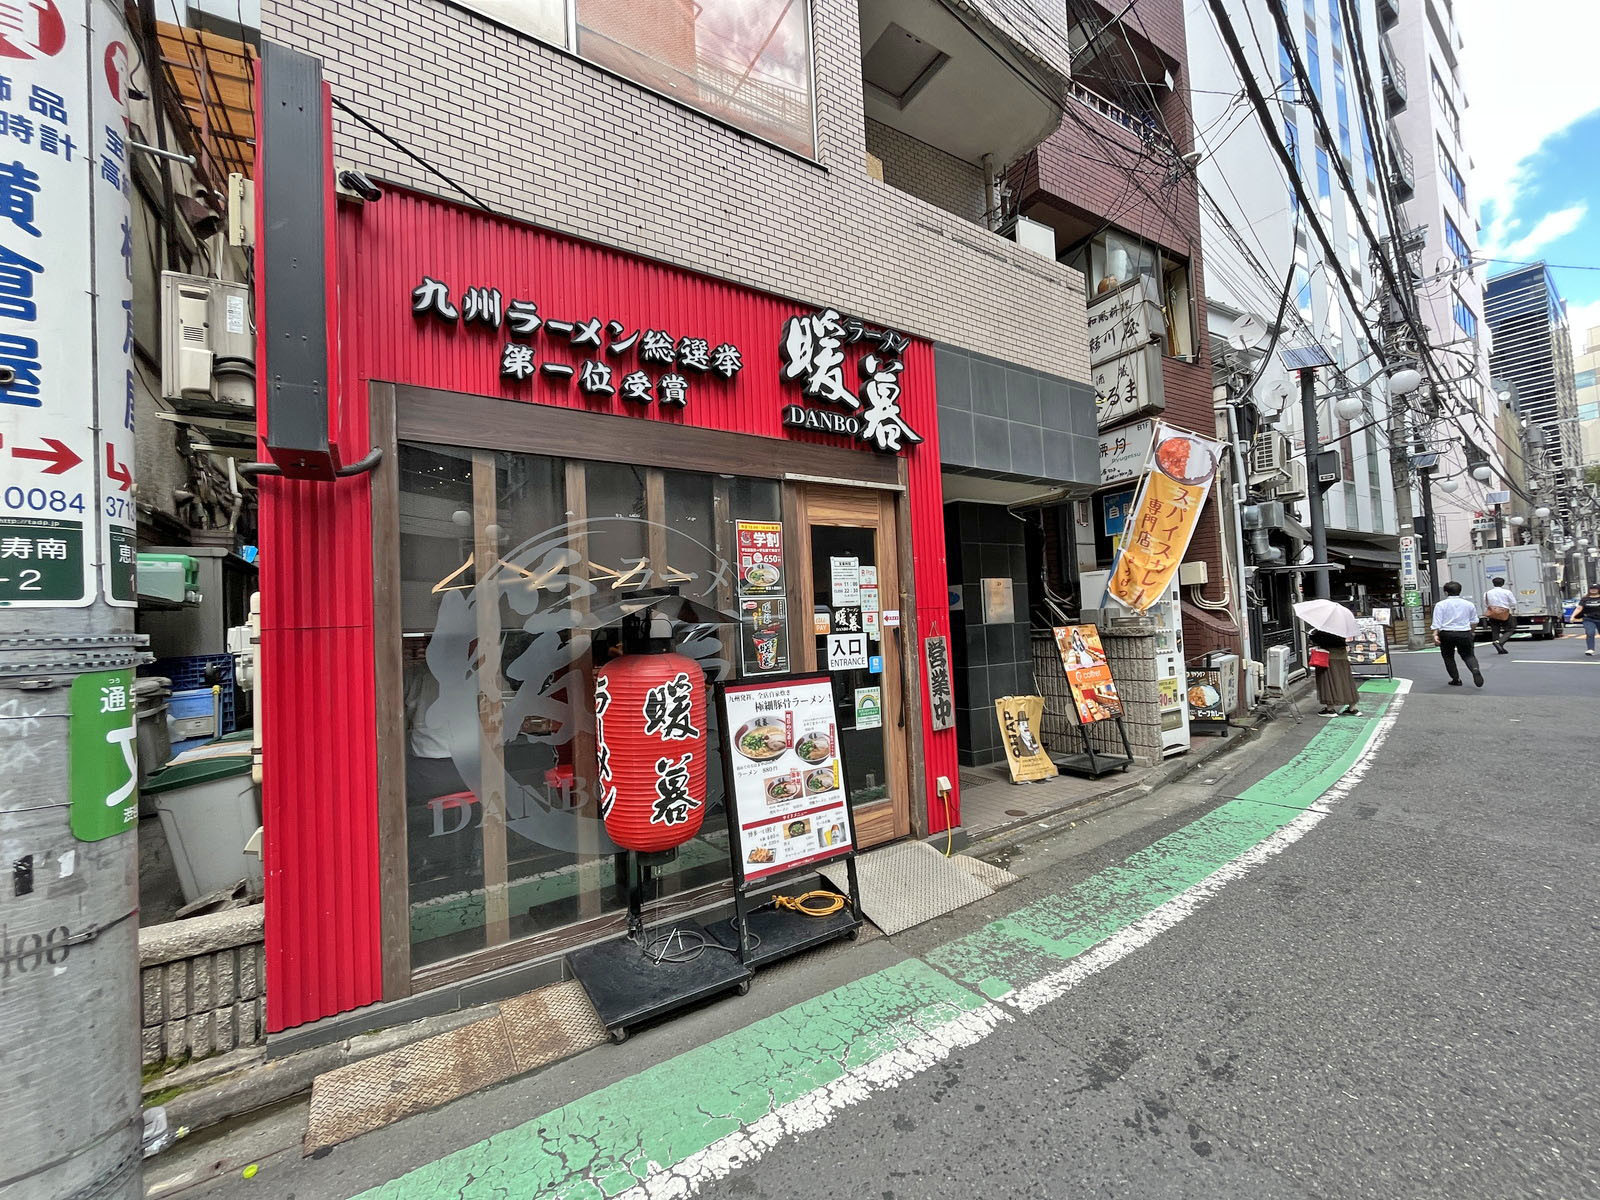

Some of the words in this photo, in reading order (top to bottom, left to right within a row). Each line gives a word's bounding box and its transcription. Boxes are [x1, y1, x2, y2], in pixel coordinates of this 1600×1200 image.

[412, 276, 743, 378] 九州ラーメン総選挙
[846, 316, 911, 354] ラーメン
[501, 342, 689, 409] 第一位受賞
[788, 405, 859, 435] DANBO
[1137, 422, 1150, 431] B1F
[753, 531, 780, 548] 学割
[1136, 498, 1163, 548] 専門店
[830, 657, 866, 668] ENTRANCE
[832, 639, 862, 656] 入口
[927, 639, 952, 726] 営業中
